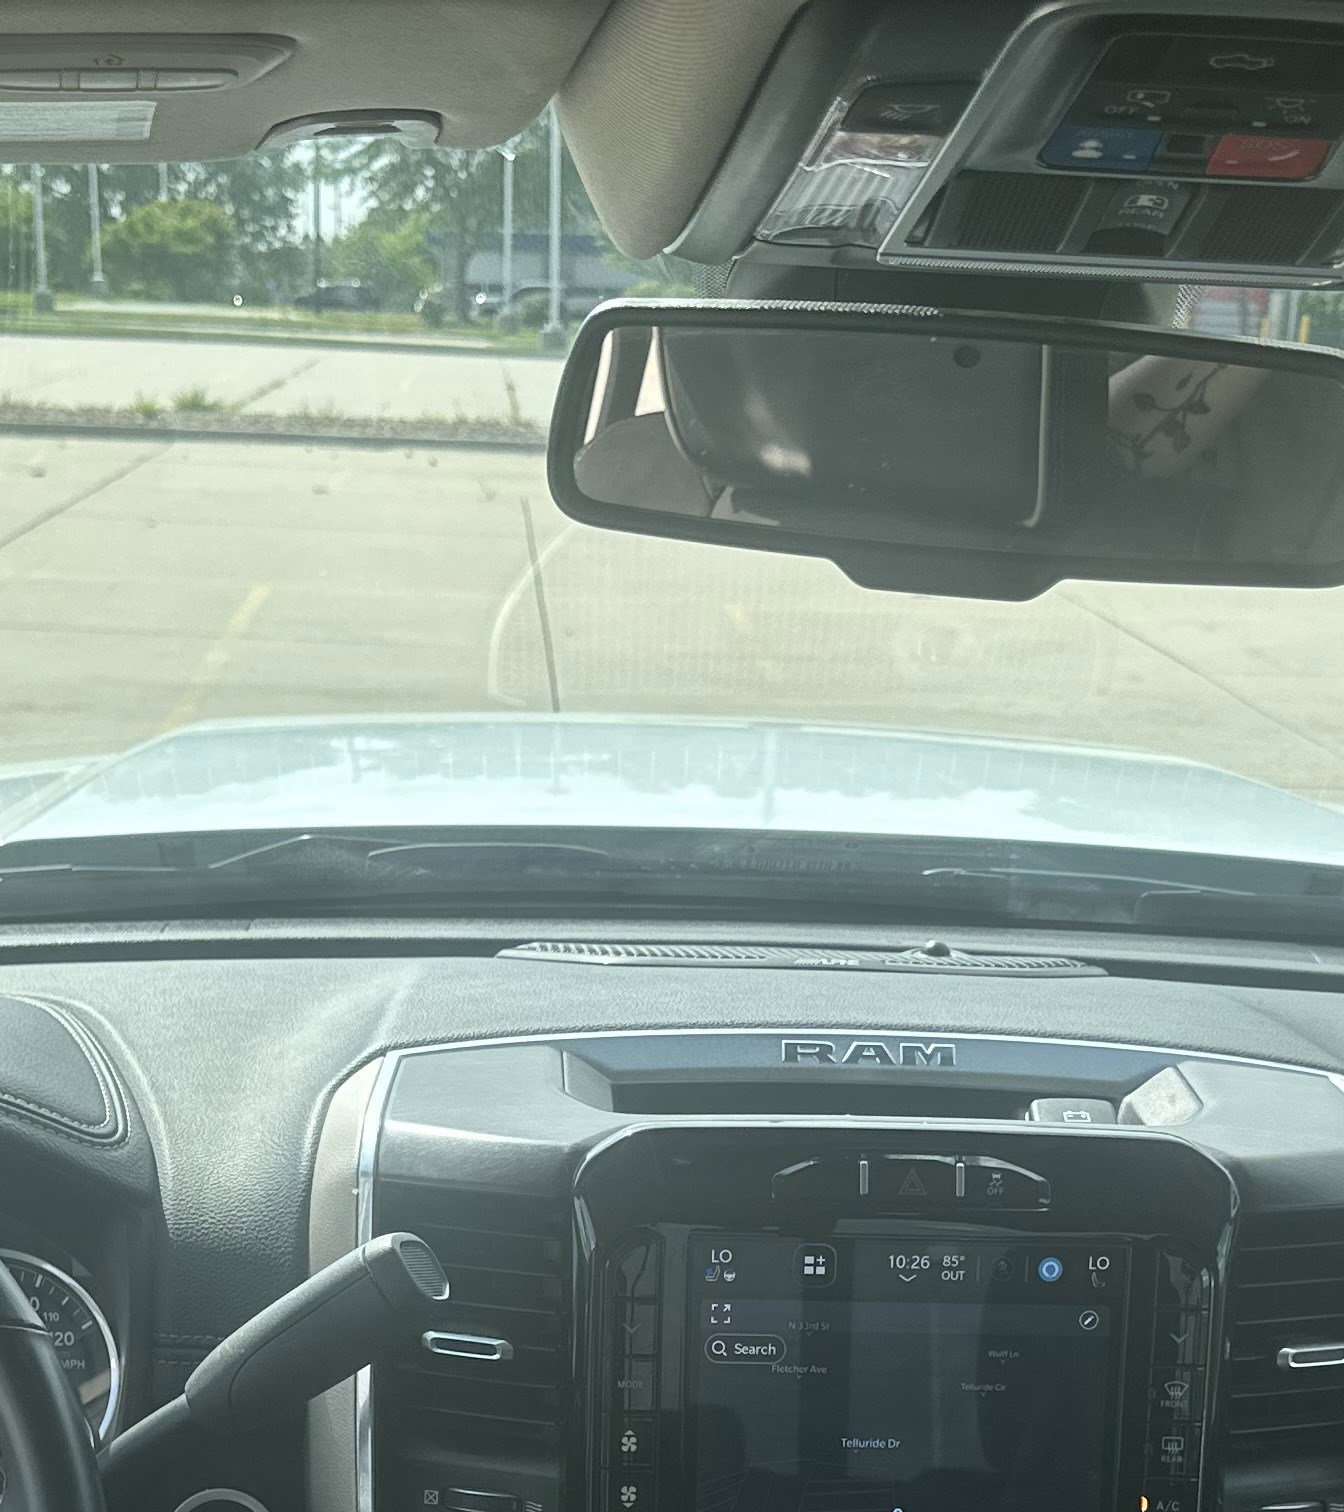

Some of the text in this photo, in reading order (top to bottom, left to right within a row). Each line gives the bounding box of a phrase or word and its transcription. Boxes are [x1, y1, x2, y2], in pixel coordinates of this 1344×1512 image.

[781, 1039, 957, 1066] RAM
[987, 1187, 1004, 1196] OFF
[711, 1249, 733, 1263] LO
[942, 1255, 966, 1267] 85°
[888, 1255, 931, 1269] 10:26
[1088, 1256, 1110, 1270] LO
[941, 1271, 966, 1281] OUT
[44, 1312, 60, 1321] 110
[734, 1343, 777, 1355] Search
[771, 1365, 827, 1374] Fletcher Ave
[618, 1380, 644, 1389] MODE
[841, 1438, 901, 1448] Telluride Dr
[1156, 1501, 1180, 1512] A/C
